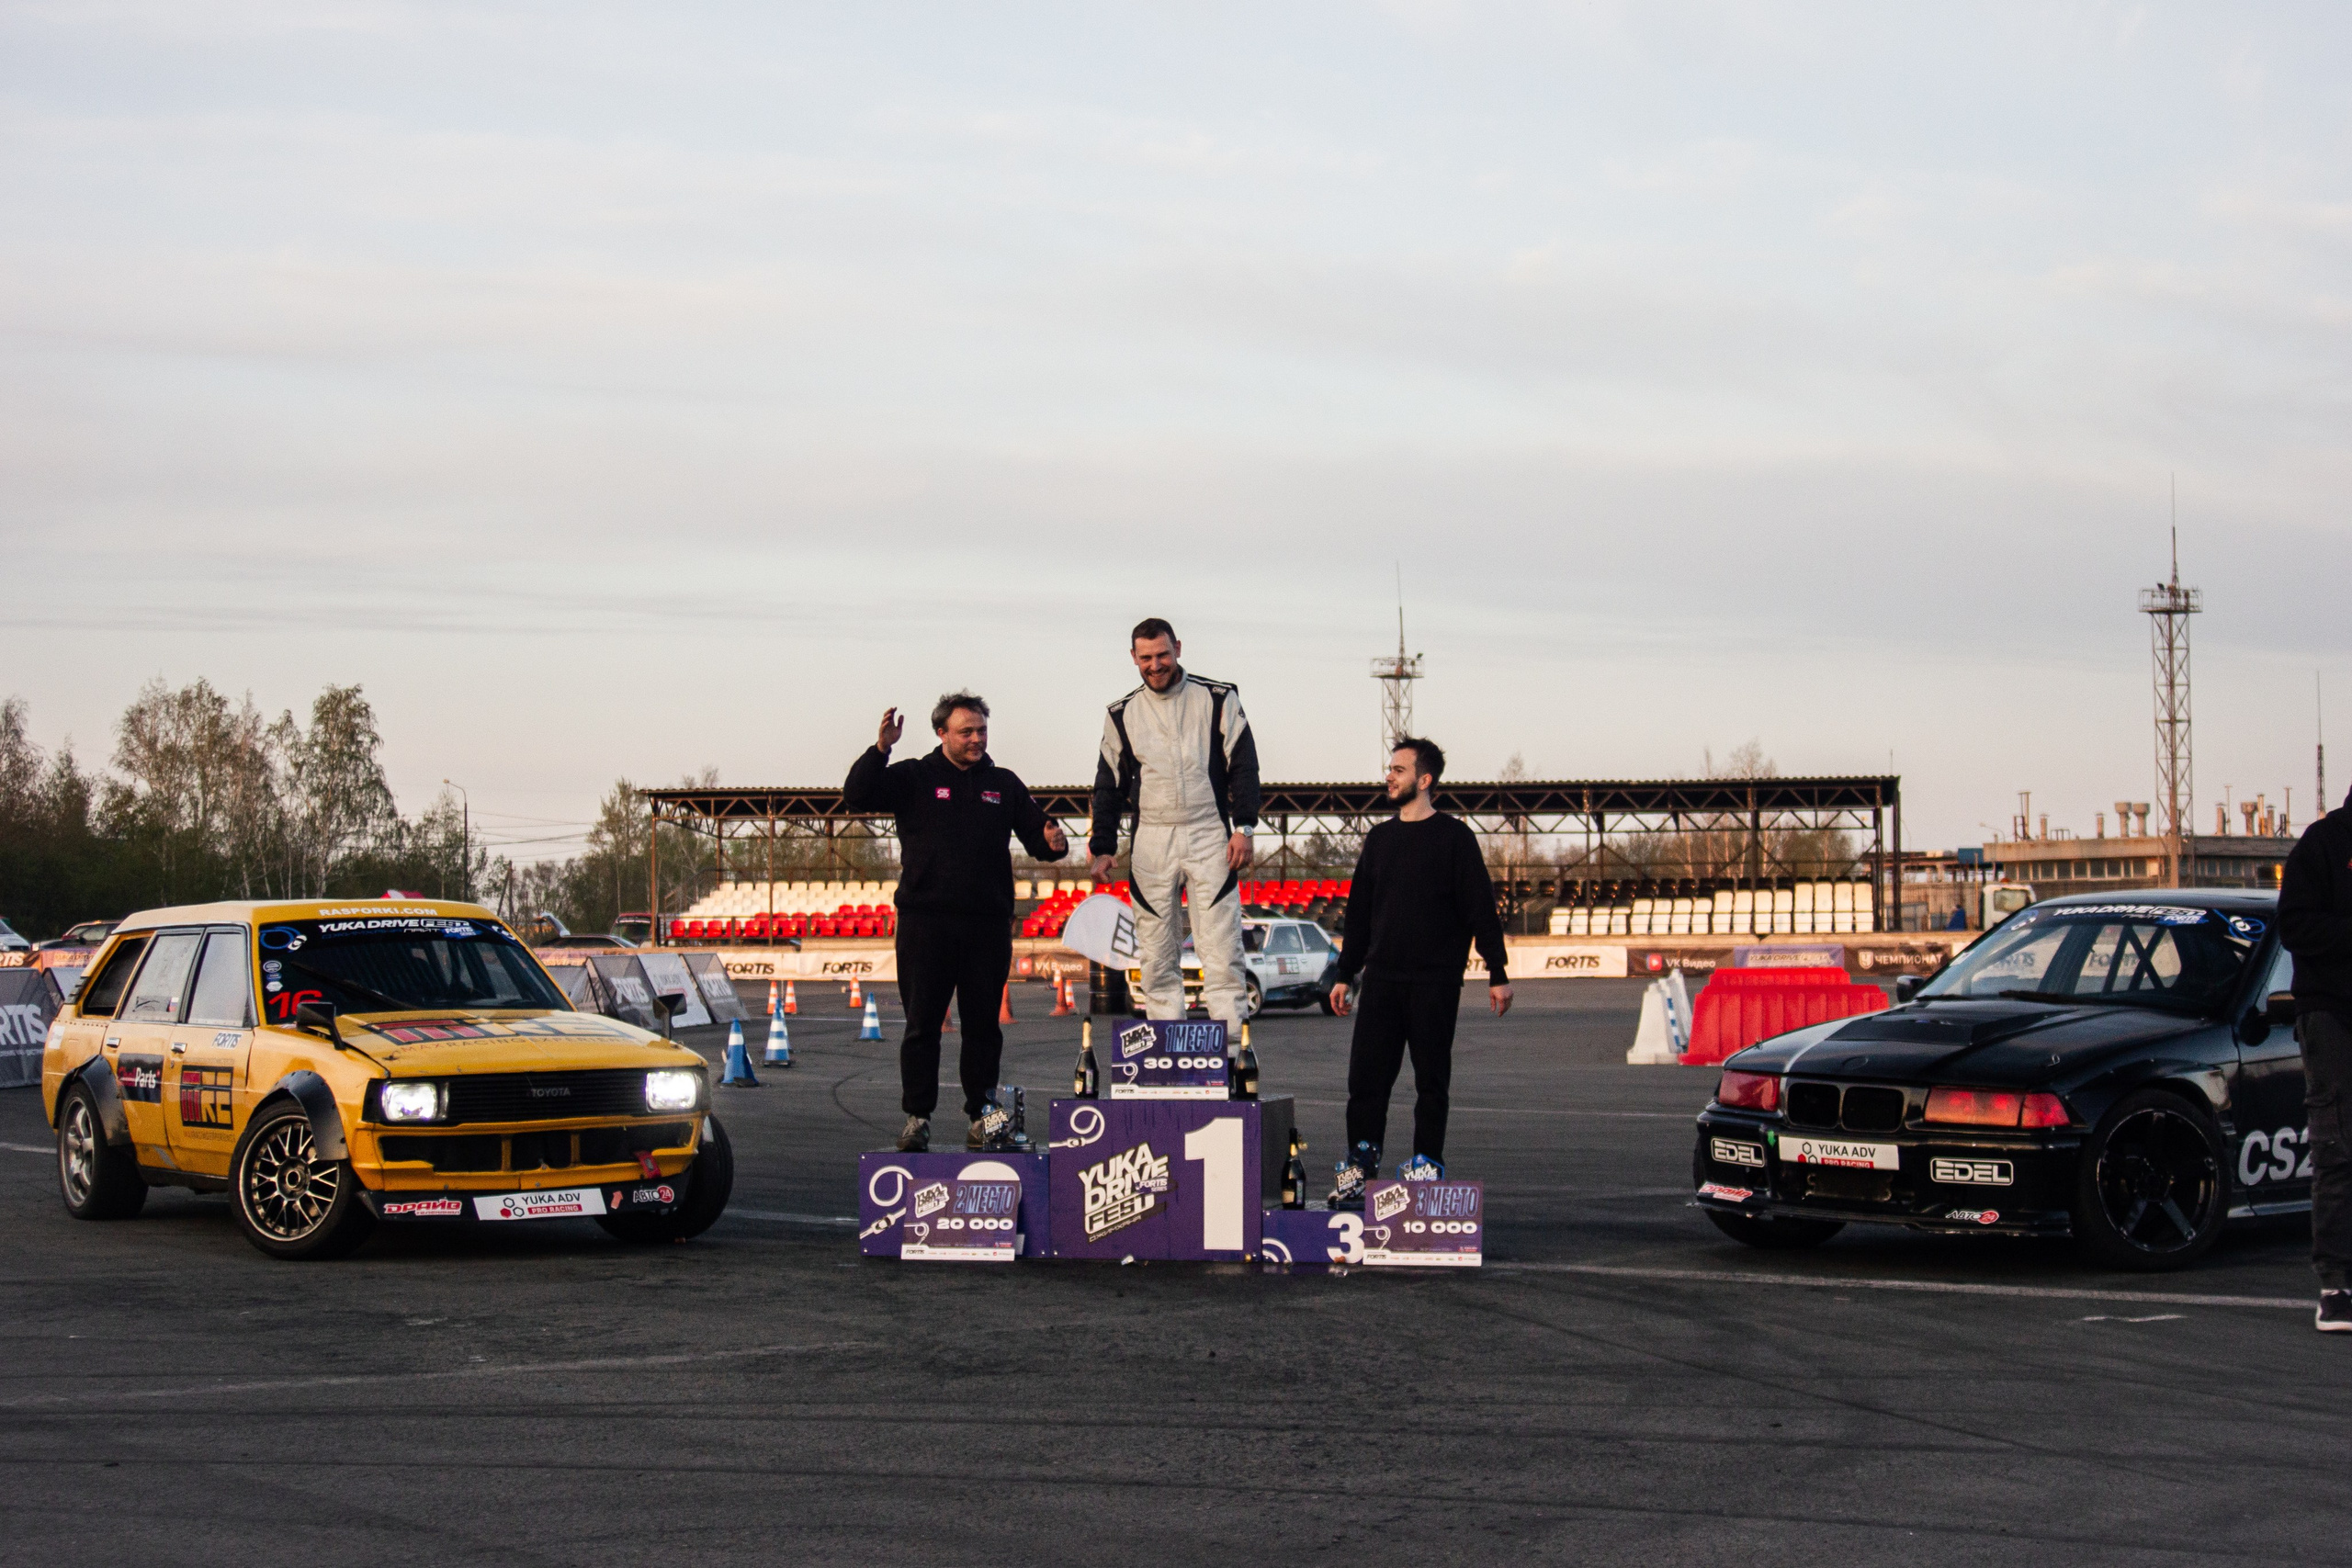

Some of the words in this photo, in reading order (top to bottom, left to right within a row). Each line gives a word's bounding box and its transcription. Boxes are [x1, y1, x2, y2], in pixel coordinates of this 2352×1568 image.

[319, 908, 437, 916] RASPORKI.COM
[319, 920, 366, 932] YUKA
[368, 919, 419, 929] DRIVE
[1545, 955, 1600, 969] FORTIS
[1666, 959, 1680, 967] VK
[1682, 958, 1716, 969] Видео
[1875, 953, 1941, 964] ЧЕМПИОНАТ
[725, 963, 775, 975] FORTIS
[822, 961, 872, 975] FORTIS
[1035, 962, 1049, 971] VK
[212, 1032, 242, 1047] FORTIS
[1165, 1024, 1174, 1052] 1
[1174, 1024, 1224, 1052] МЕСТО
[1144, 1057, 1172, 1069] 30
[1178, 1057, 1223, 1069] 000
[532, 1088, 571, 1098] TOYOTA
[1713, 1140, 1763, 1165] EDEL
[1818, 1145, 1849, 1156] YUKA
[1851, 1147, 1876, 1157] ADV
[1078, 1142, 1154, 1192] YUKA
[1841, 1160, 1871, 1168] RACING
[1935, 1160, 2011, 1183] EDEL
[1085, 1156, 1169, 1214] DRIVE
[1140, 1179, 1167, 1188] FORTIS
[1184, 1118, 1243, 1250] 1
[522, 1195, 556, 1205] YUKA
[558, 1193, 581, 1202] ADV
[954, 1185, 967, 1213] 2
[966, 1185, 1016, 1213] МЕСТО
[1416, 1187, 1428, 1216] 3
[1427, 1187, 1479, 1216] МЕСТО
[384, 1199, 461, 1213] ДРАЙВ
[1086, 1194, 1155, 1234] FEST
[937, 1218, 965, 1230] 20
[969, 1218, 1013, 1230] 000
[1403, 1221, 1426, 1234] 10
[1430, 1221, 1477, 1234] 000
[1327, 1213, 1364, 1264] 3
